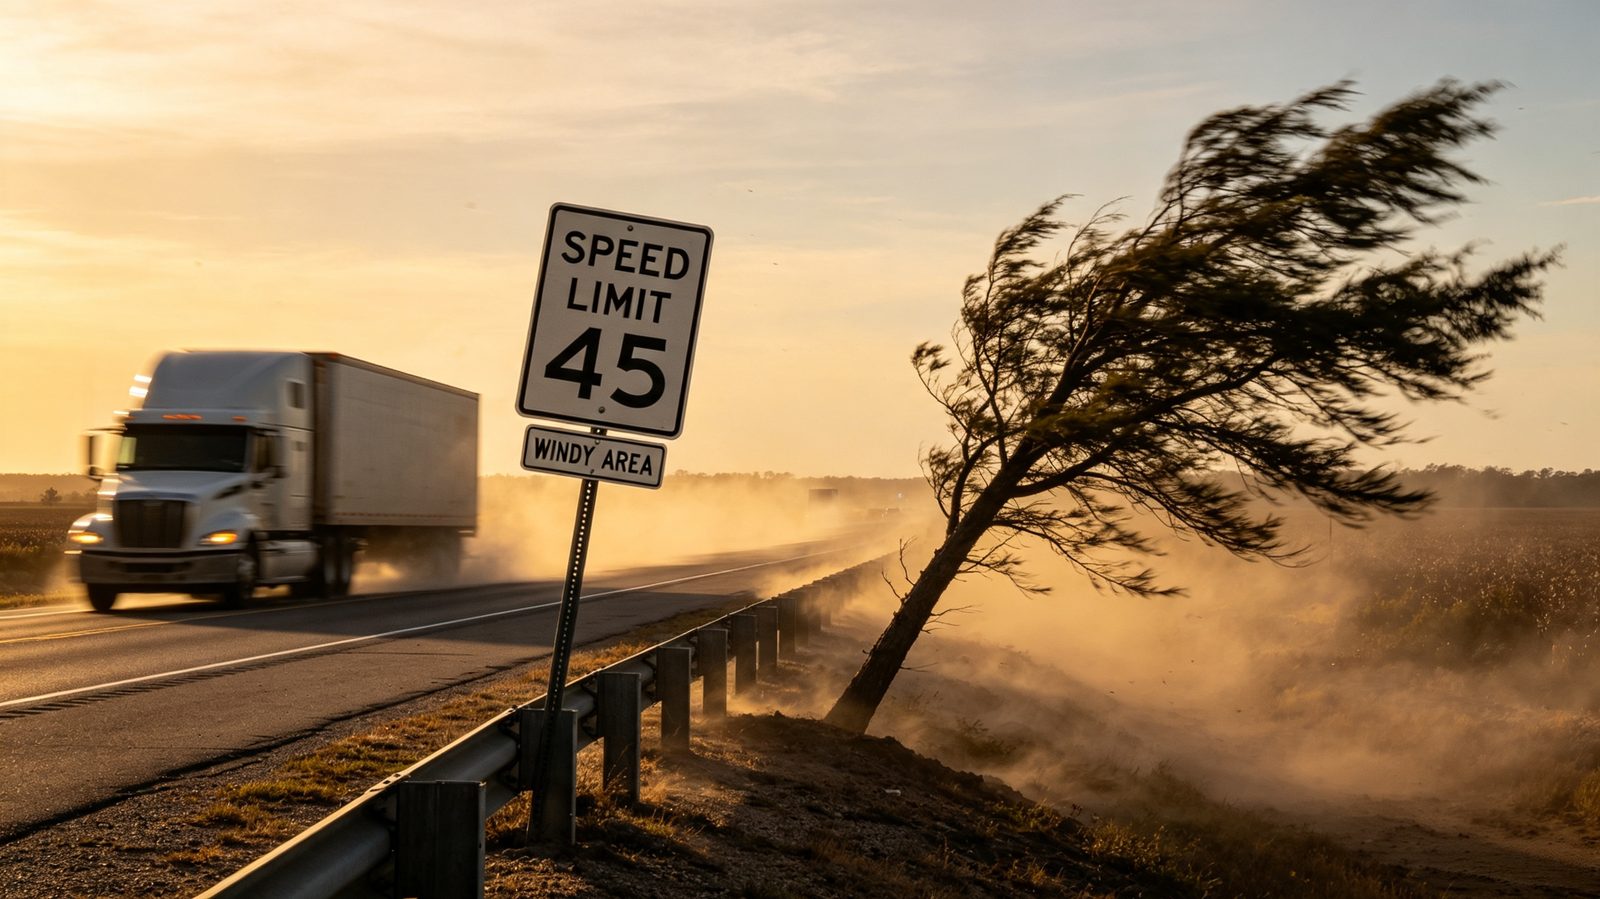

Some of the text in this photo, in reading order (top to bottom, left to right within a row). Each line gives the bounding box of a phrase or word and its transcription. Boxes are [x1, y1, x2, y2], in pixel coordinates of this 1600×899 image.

[561, 230, 690, 280] SPEED
[567, 277, 672, 324] LIMIT
[544, 327, 667, 409] 45
[535, 437, 652, 476] WINDY AREA
